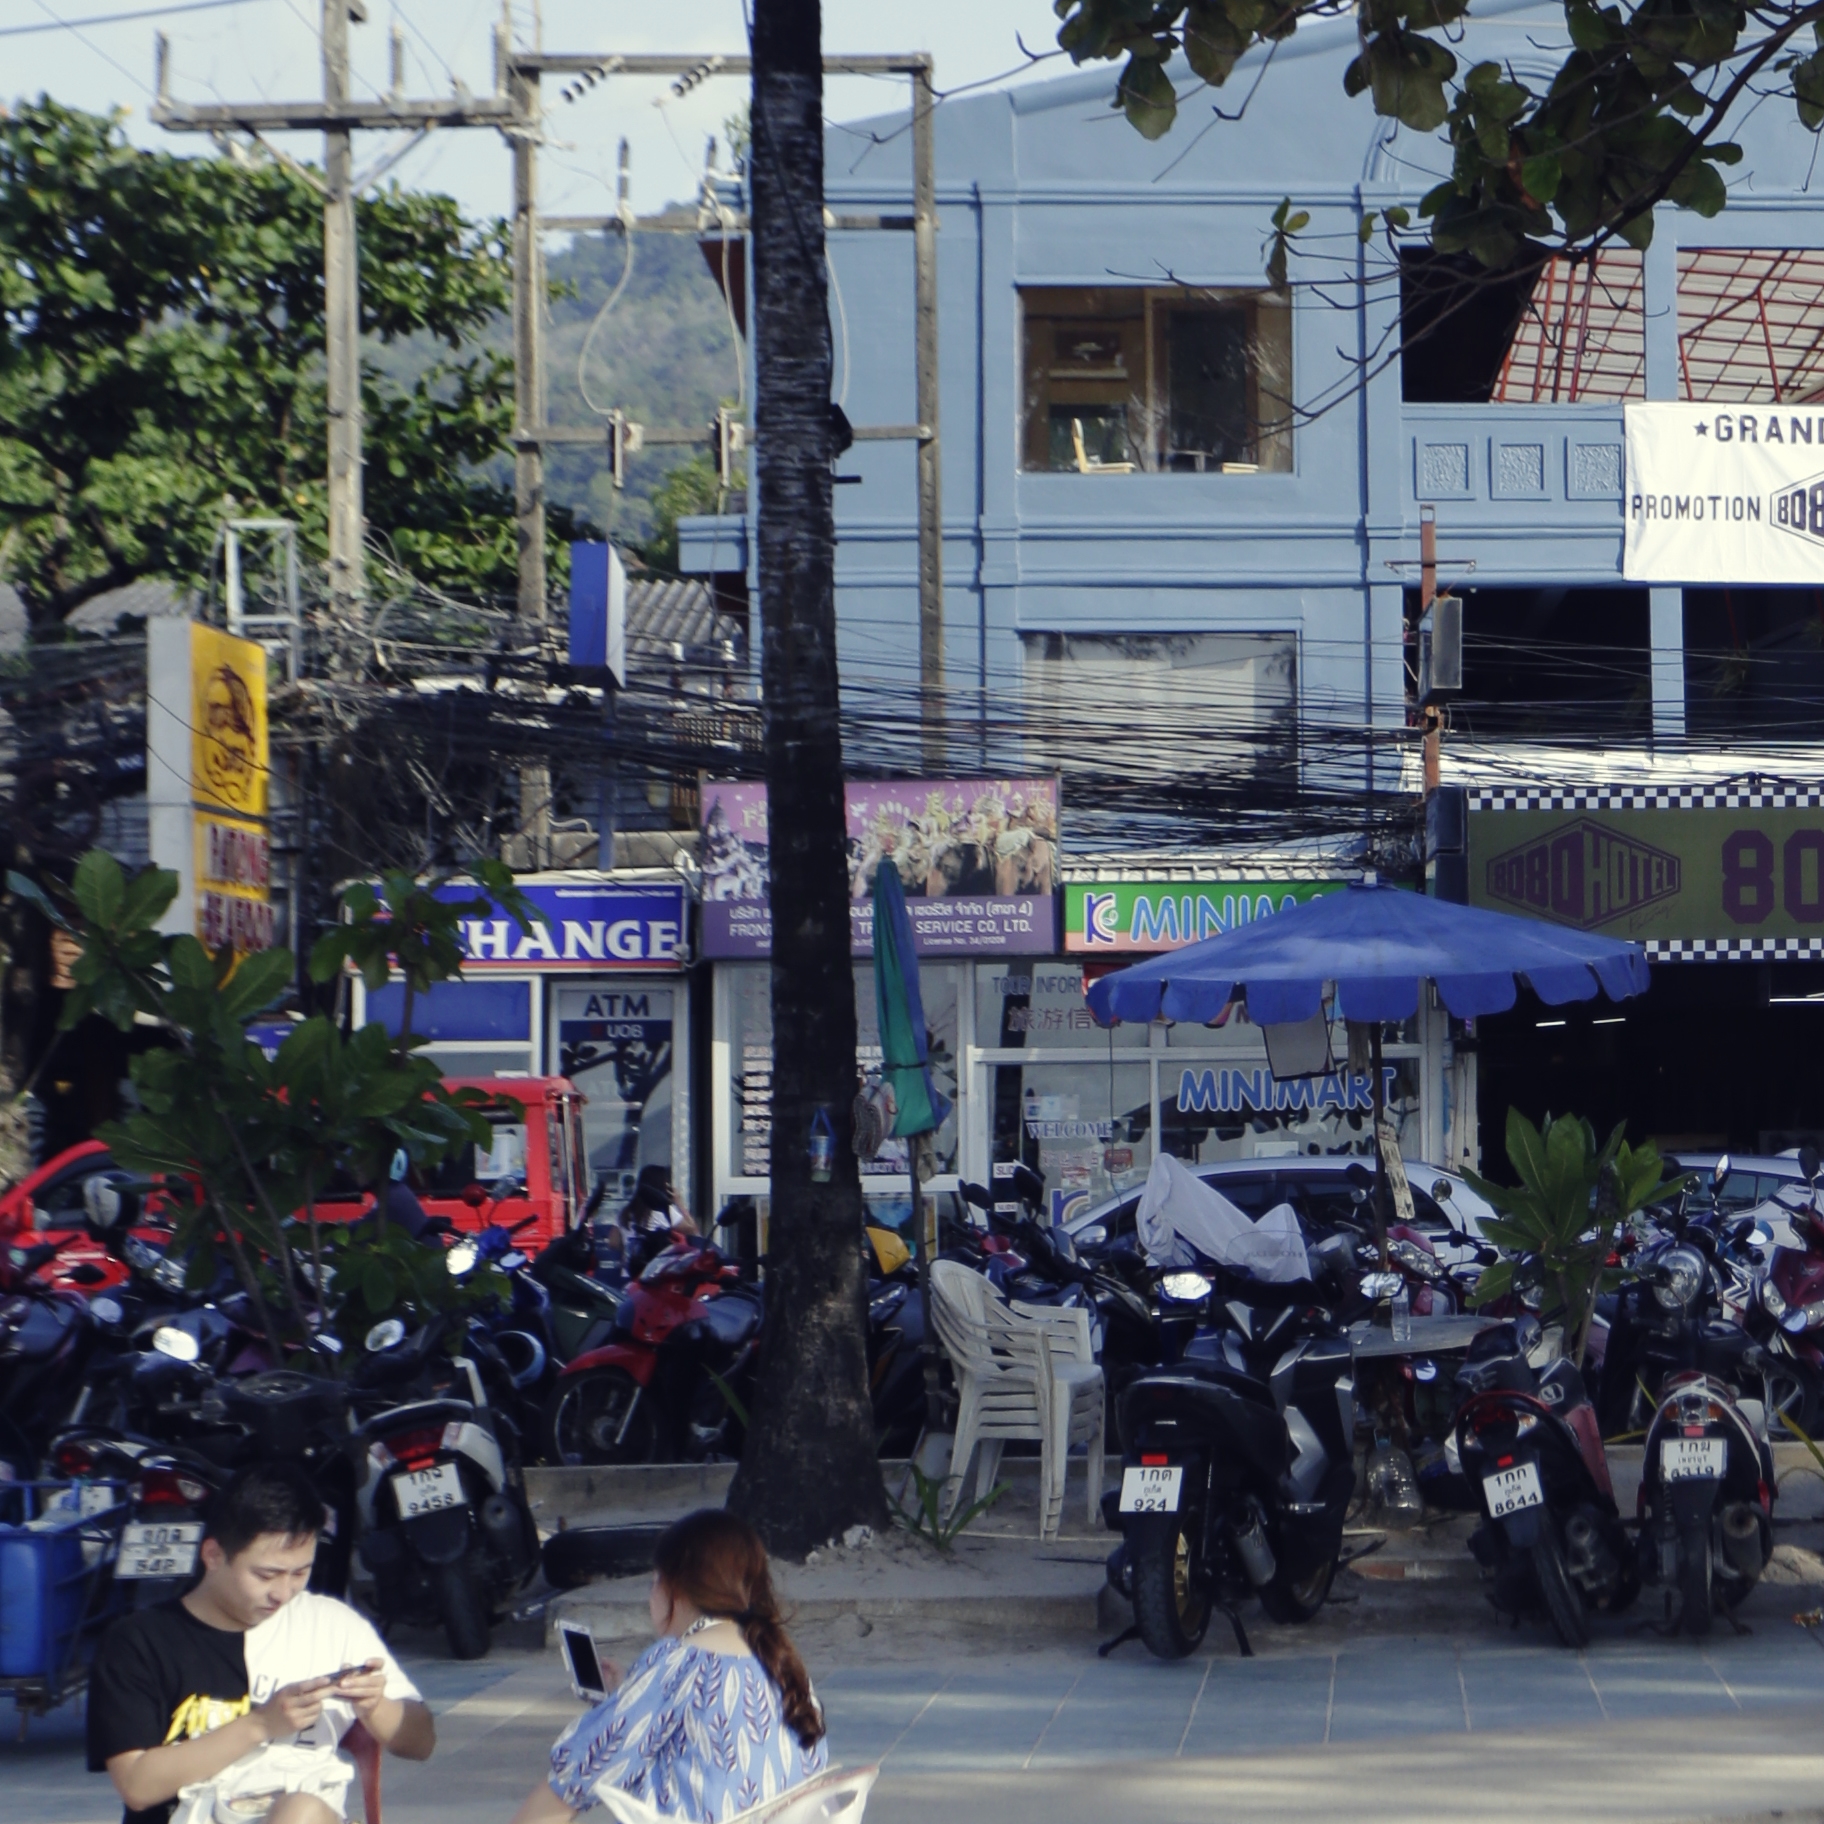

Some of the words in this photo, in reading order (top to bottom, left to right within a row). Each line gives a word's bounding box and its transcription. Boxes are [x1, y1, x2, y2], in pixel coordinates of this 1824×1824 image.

[1631, 493, 1762, 522] PROMOTION
[1584, 826, 1678, 921] HOTEL
[915, 919, 974, 935] SERVICE
[1003, 918, 1033, 933] LTD.
[992, 976, 1030, 996] TOUR
[584, 994, 650, 1018] ATM
[607, 1024, 643, 1039] UOB
[1177, 1067, 1398, 1113] MINIMART
[1026, 1121, 1113, 1139] WELCOME
[1494, 1467, 1527, 1487] 1กก
[1133, 1497, 1167, 1512] 924
[1494, 1491, 1539, 1516] 8644
